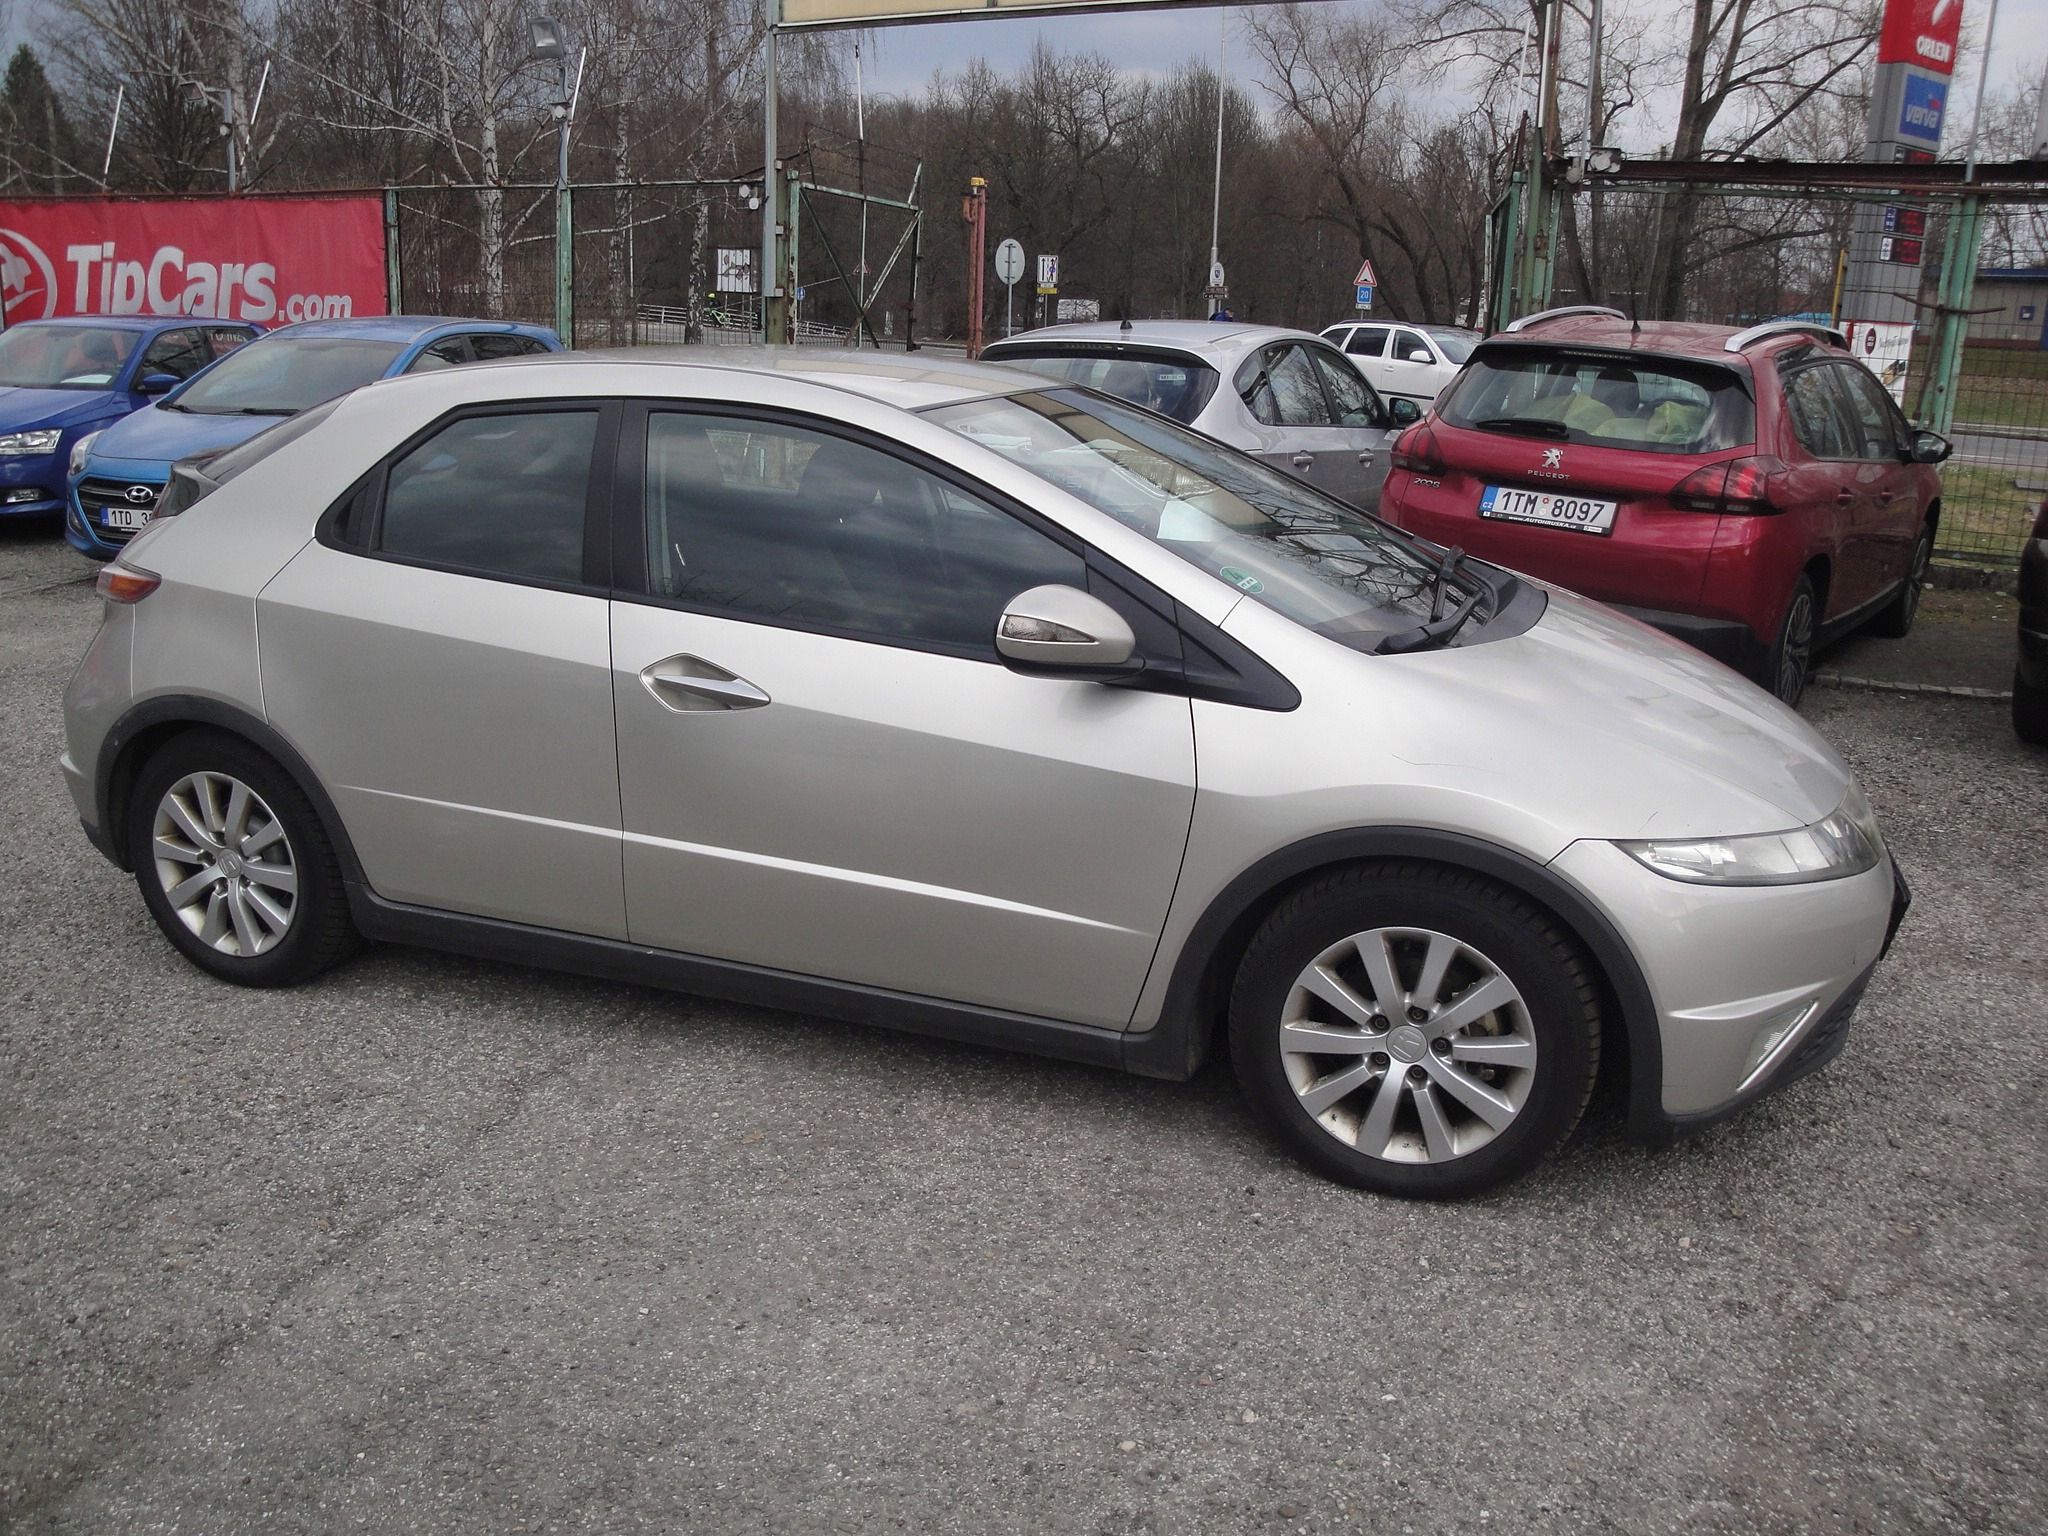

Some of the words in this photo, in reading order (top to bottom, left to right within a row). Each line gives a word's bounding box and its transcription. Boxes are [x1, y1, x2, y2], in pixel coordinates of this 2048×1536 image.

[1916, 35, 1951, 63] ORLEN
[1905, 103, 1939, 129] verva
[66, 241, 353, 323] TipCars.com
[1360, 290, 1369, 299] 20
[1414, 477, 1441, 488] 2008
[1527, 469, 1571, 480] PEUGEOT
[1482, 501, 1493, 509] CZ
[1502, 491, 1539, 515] 1TM
[1551, 498, 1605, 523] 8097
[111, 510, 132, 526] 1TD
